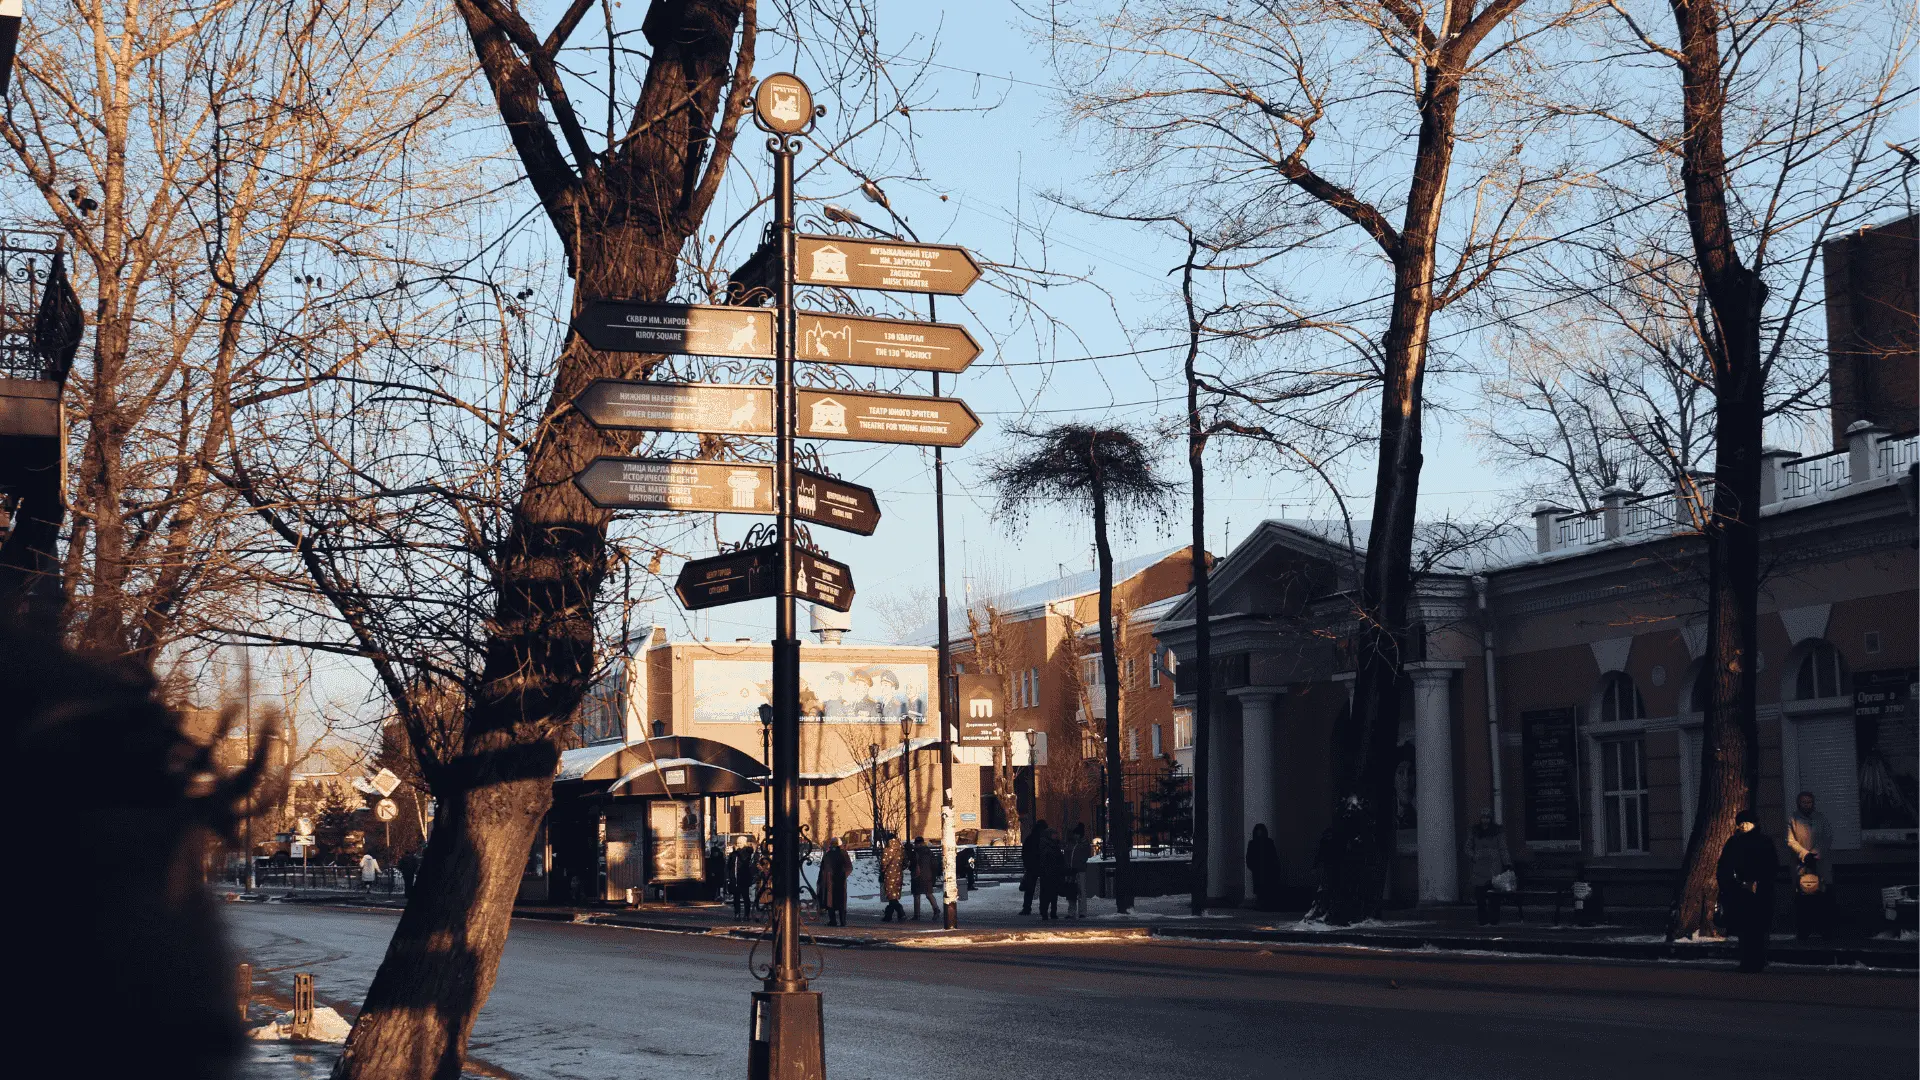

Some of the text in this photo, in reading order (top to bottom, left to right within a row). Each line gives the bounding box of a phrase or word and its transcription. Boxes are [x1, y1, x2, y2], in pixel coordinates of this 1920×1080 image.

[870, 247, 939, 259] МУЗЫКАЛЬНЫЙ ТЕАТР
[880, 257, 931, 267] ИМ. ЗАГУРСКОГО
[890, 269, 921, 278] ZAGURSKY
[883, 277, 929, 288] MUSIC THEATRE
[626, 315, 691, 326] СКВЕР ИМ. КИРОВА
[635, 331, 682, 341] KIROV SQUARE
[884, 332, 924, 342] 130 КВАРТАЛ
[875, 347, 887, 356] THE
[904, 350, 932, 359] DISTRICT
[620, 392, 698, 403] НИЖНЯЯ НАБЕРЕЖНАЯ
[623, 410, 694, 420] LOWER EMBANKMENT
[869, 406, 939, 419] ТЕАТР ЮНОГО ЗРИТЕЛЯ
[859, 421, 948, 434] THEATRE FOR YOUNG AUDIENCE
[623, 464, 698, 475] УЛИЦА КАРЛА МАРКСА
[623, 473, 699, 484] ИСТОРИЧЕСКИЙ ЦЕНТР
[630, 485, 692, 496] KARL MARX STREET
[628, 494, 667, 503] HISTORICAL
[1857, 692, 1896, 704] Орган в
[1855, 705, 1905, 716] стиле этно
